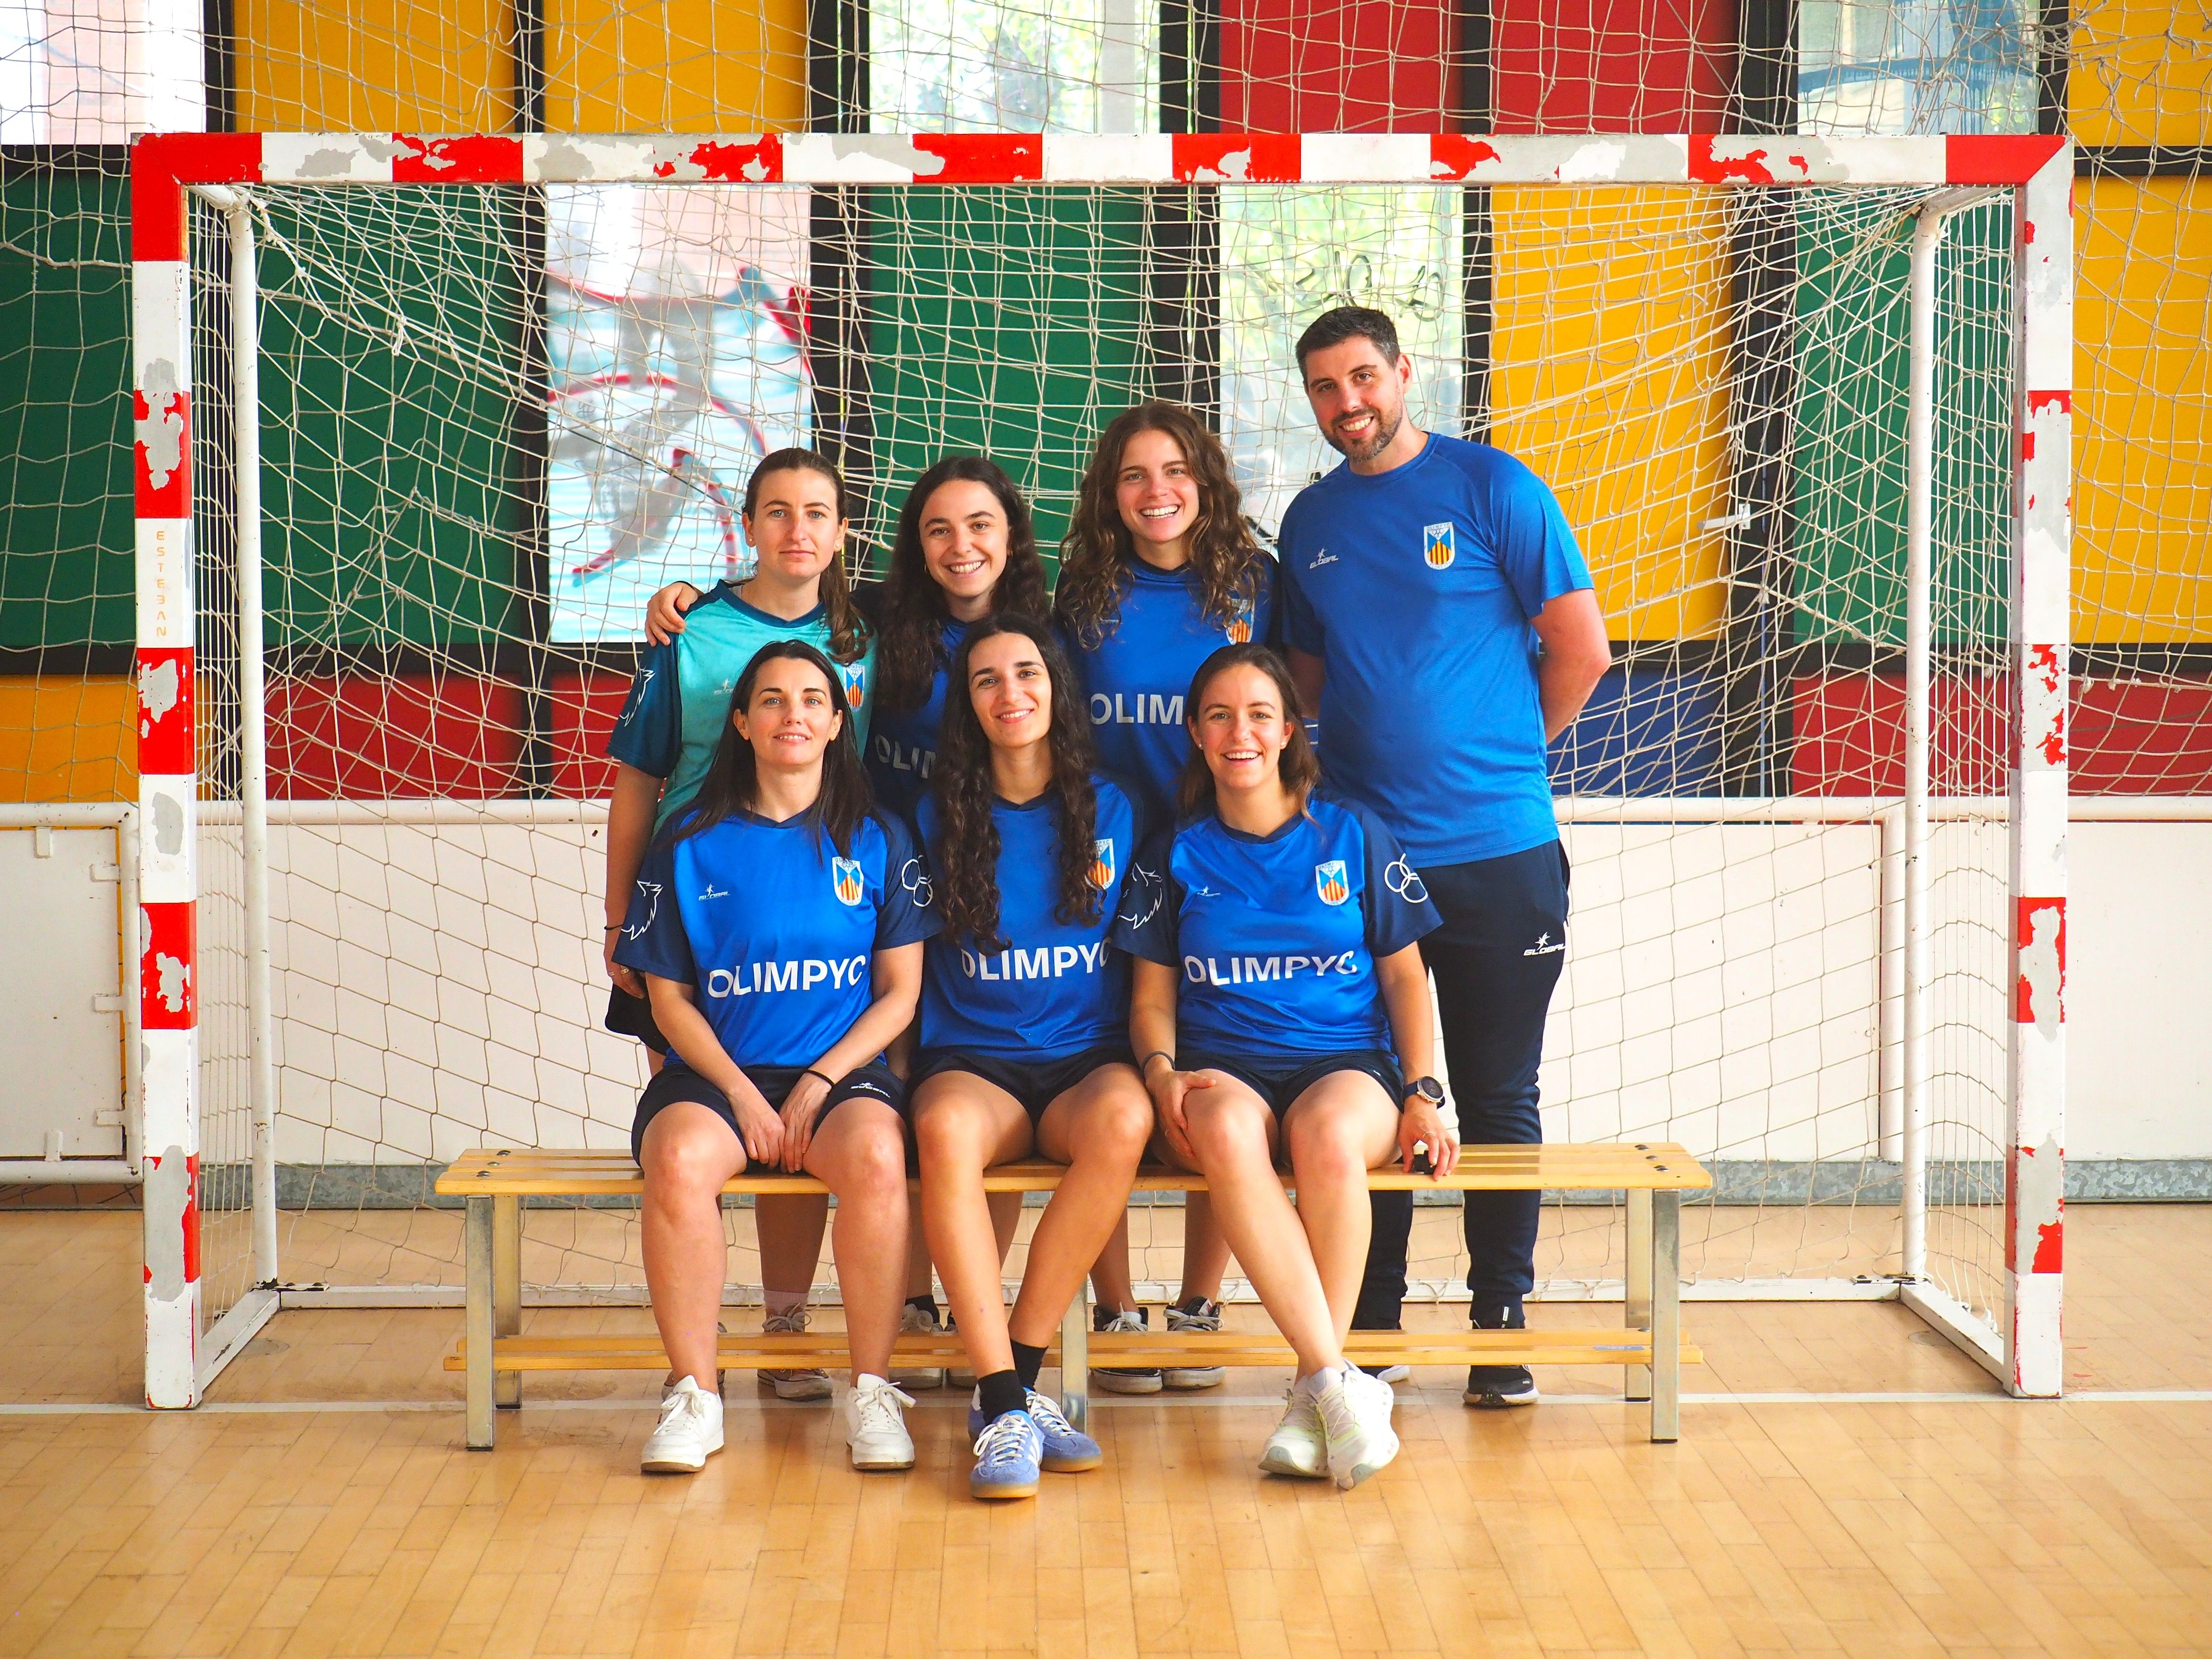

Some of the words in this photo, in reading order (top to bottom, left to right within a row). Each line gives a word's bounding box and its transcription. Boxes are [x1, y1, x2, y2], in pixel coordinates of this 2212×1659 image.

[1310, 555, 1339, 569] GLOBAL
[1090, 693, 1184, 725] OLIM
[875, 734, 937, 780] OLIM
[1523, 943, 1566, 956] GLOBAL
[708, 955, 866, 998] OLIMPYC
[1184, 950, 1358, 986] OLIMPYC
